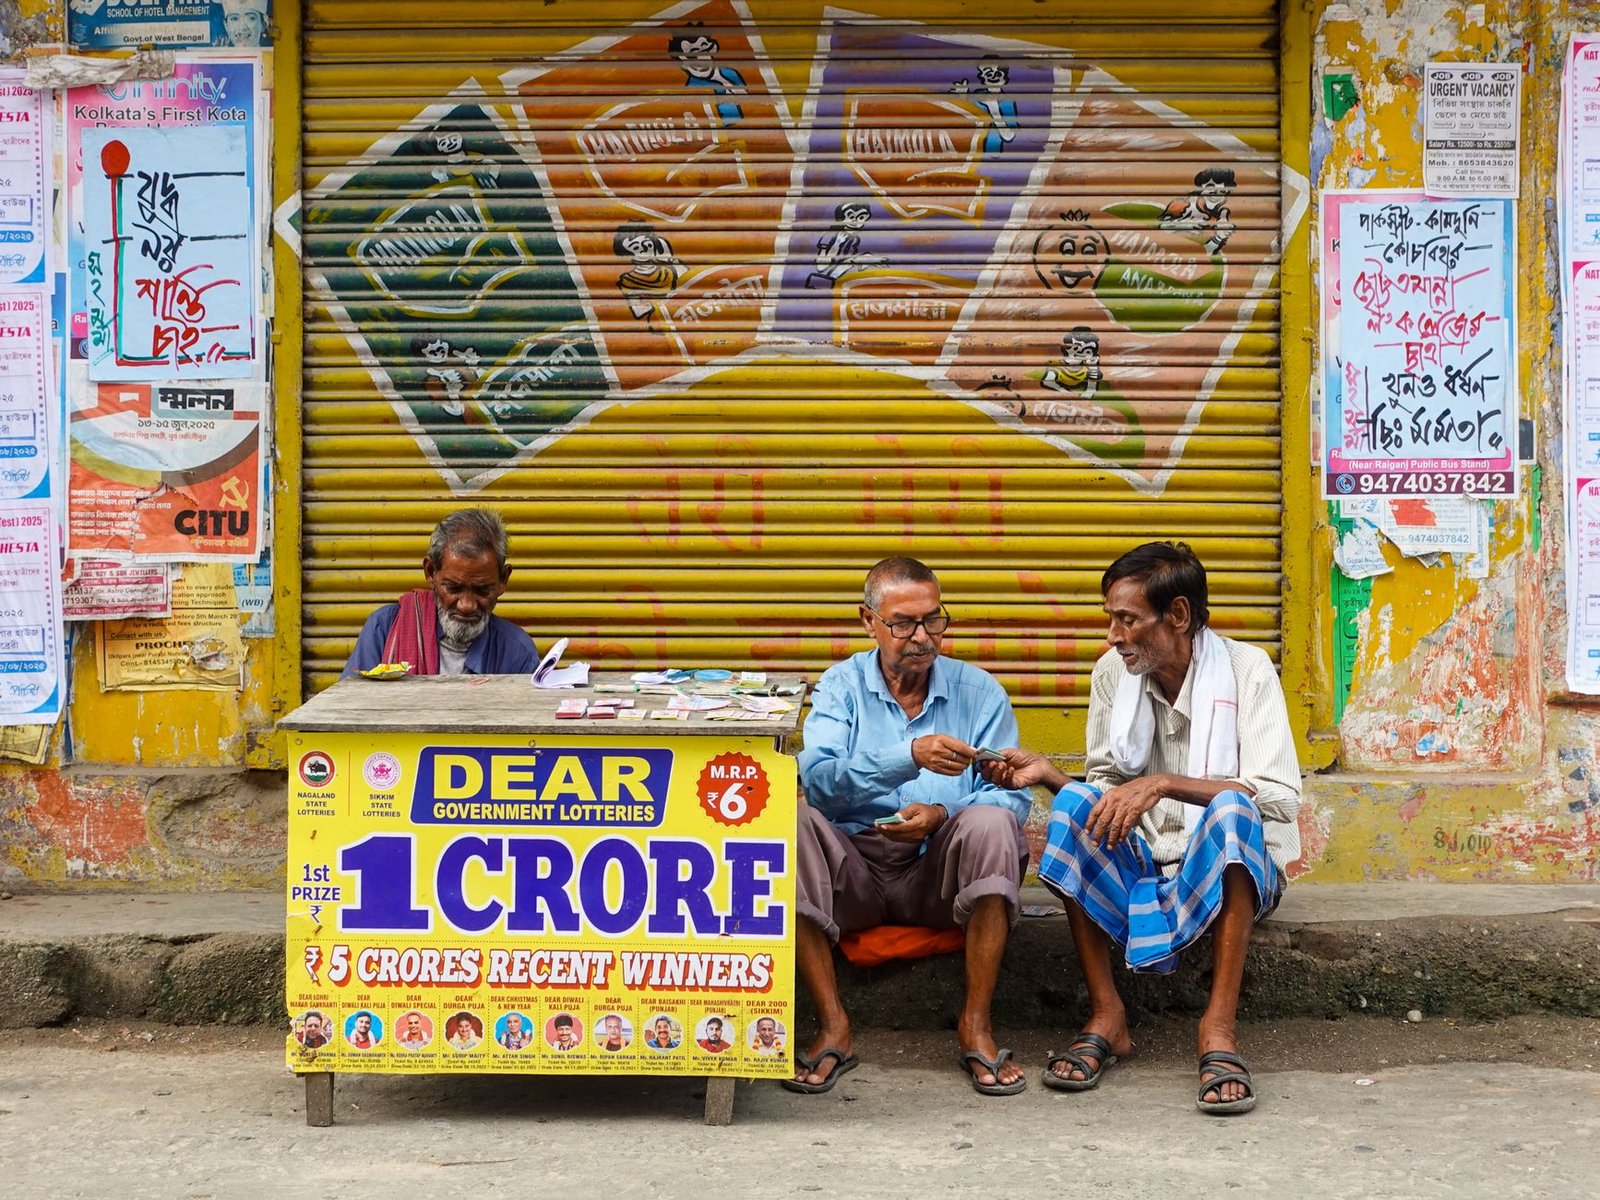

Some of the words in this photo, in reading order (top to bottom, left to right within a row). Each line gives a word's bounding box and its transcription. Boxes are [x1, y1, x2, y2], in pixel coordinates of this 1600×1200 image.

[107, 8, 132, 18] SCHOOL
[135, 8, 143, 16] OF
[144, 7, 164, 16] HOTEL
[166, 6, 210, 16] MANAGEMENT
[176, 34, 204, 43] Bengal
[1430, 82, 1468, 96] URGENT
[1471, 83, 1515, 97] VACANCY
[75, 106, 156, 120] Kolkata's
[162, 106, 202, 120] First
[208, 106, 246, 120] Kota
[1428, 140, 1446, 150] Salary
[12, 301, 35, 311] 2025
[1349, 460, 1372, 470] (Near
[1375, 460, 1409, 472] Raiganj
[1411, 460, 1440, 470] Public
[1442, 460, 1459, 470] Bus
[1461, 460, 1490, 470] Stand)
[1360, 474, 1506, 493] 9474037842
[22, 516, 43, 526] 2025
[174, 510, 250, 537] CITU
[1408, 534, 1469, 544] 9474037842
[242, 599, 264, 607] (WB)
[434, 754, 655, 802] DEAR
[710, 765, 759, 780] M.R.P.
[433, 802, 554, 821] GOVERNMENT
[560, 804, 655, 822] LOTTERIES
[302, 864, 330, 882] 1st
[436, 834, 786, 937] CRORE
[292, 886, 340, 901] PRIZE
[328, 944, 352, 987] 5
[357, 946, 484, 989] CRORES
[487, 948, 616, 990] RECENT
[621, 950, 774, 994] WINNERS
